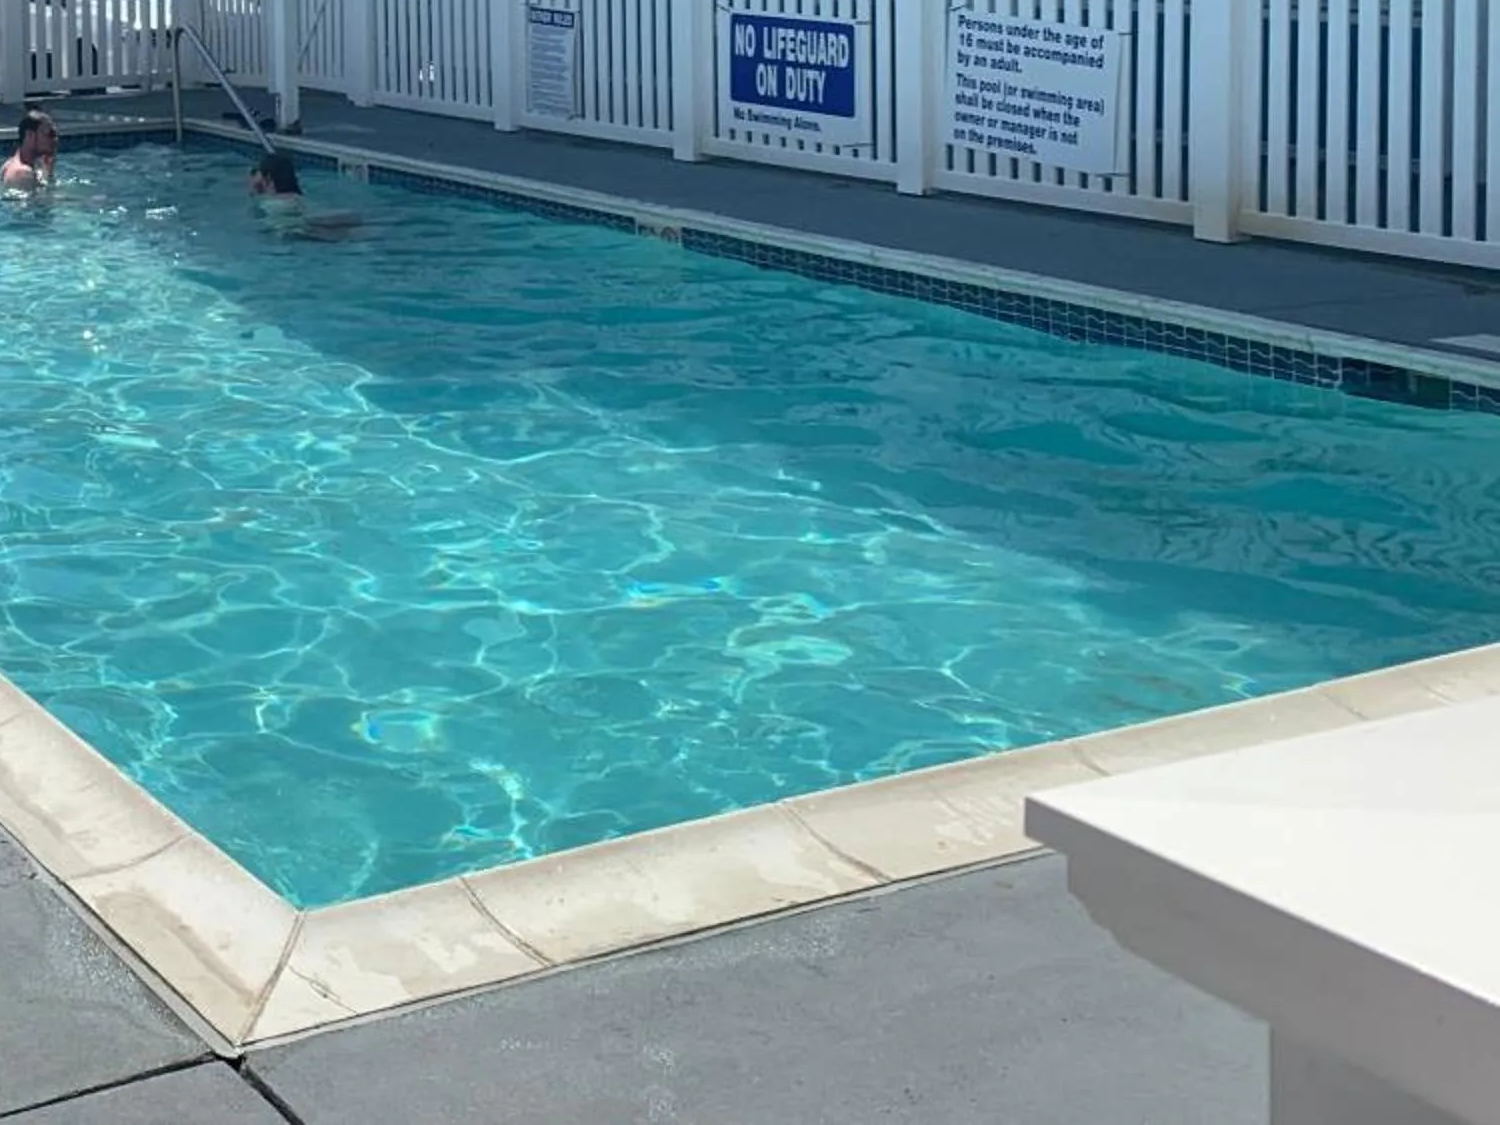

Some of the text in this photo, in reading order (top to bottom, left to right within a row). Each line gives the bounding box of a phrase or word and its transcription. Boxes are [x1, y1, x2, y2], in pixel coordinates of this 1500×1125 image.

[734, 23, 849, 68] NO LIFEGUARD
[957, 14, 1105, 50] Persons under the age of
[960, 32, 1105, 69] 16 must be accompanied
[956, 48, 1022, 73] by an adult.
[755, 62, 827, 105] ON DUTY
[955, 72, 977, 90] This
[979, 78, 1001, 94] pool
[1020, 86, 1073, 111] swimming
[955, 91, 1080, 128] shall be closed when the
[953, 128, 1037, 155] on the premises.
[955, 111, 1078, 146] owner or manager is not
